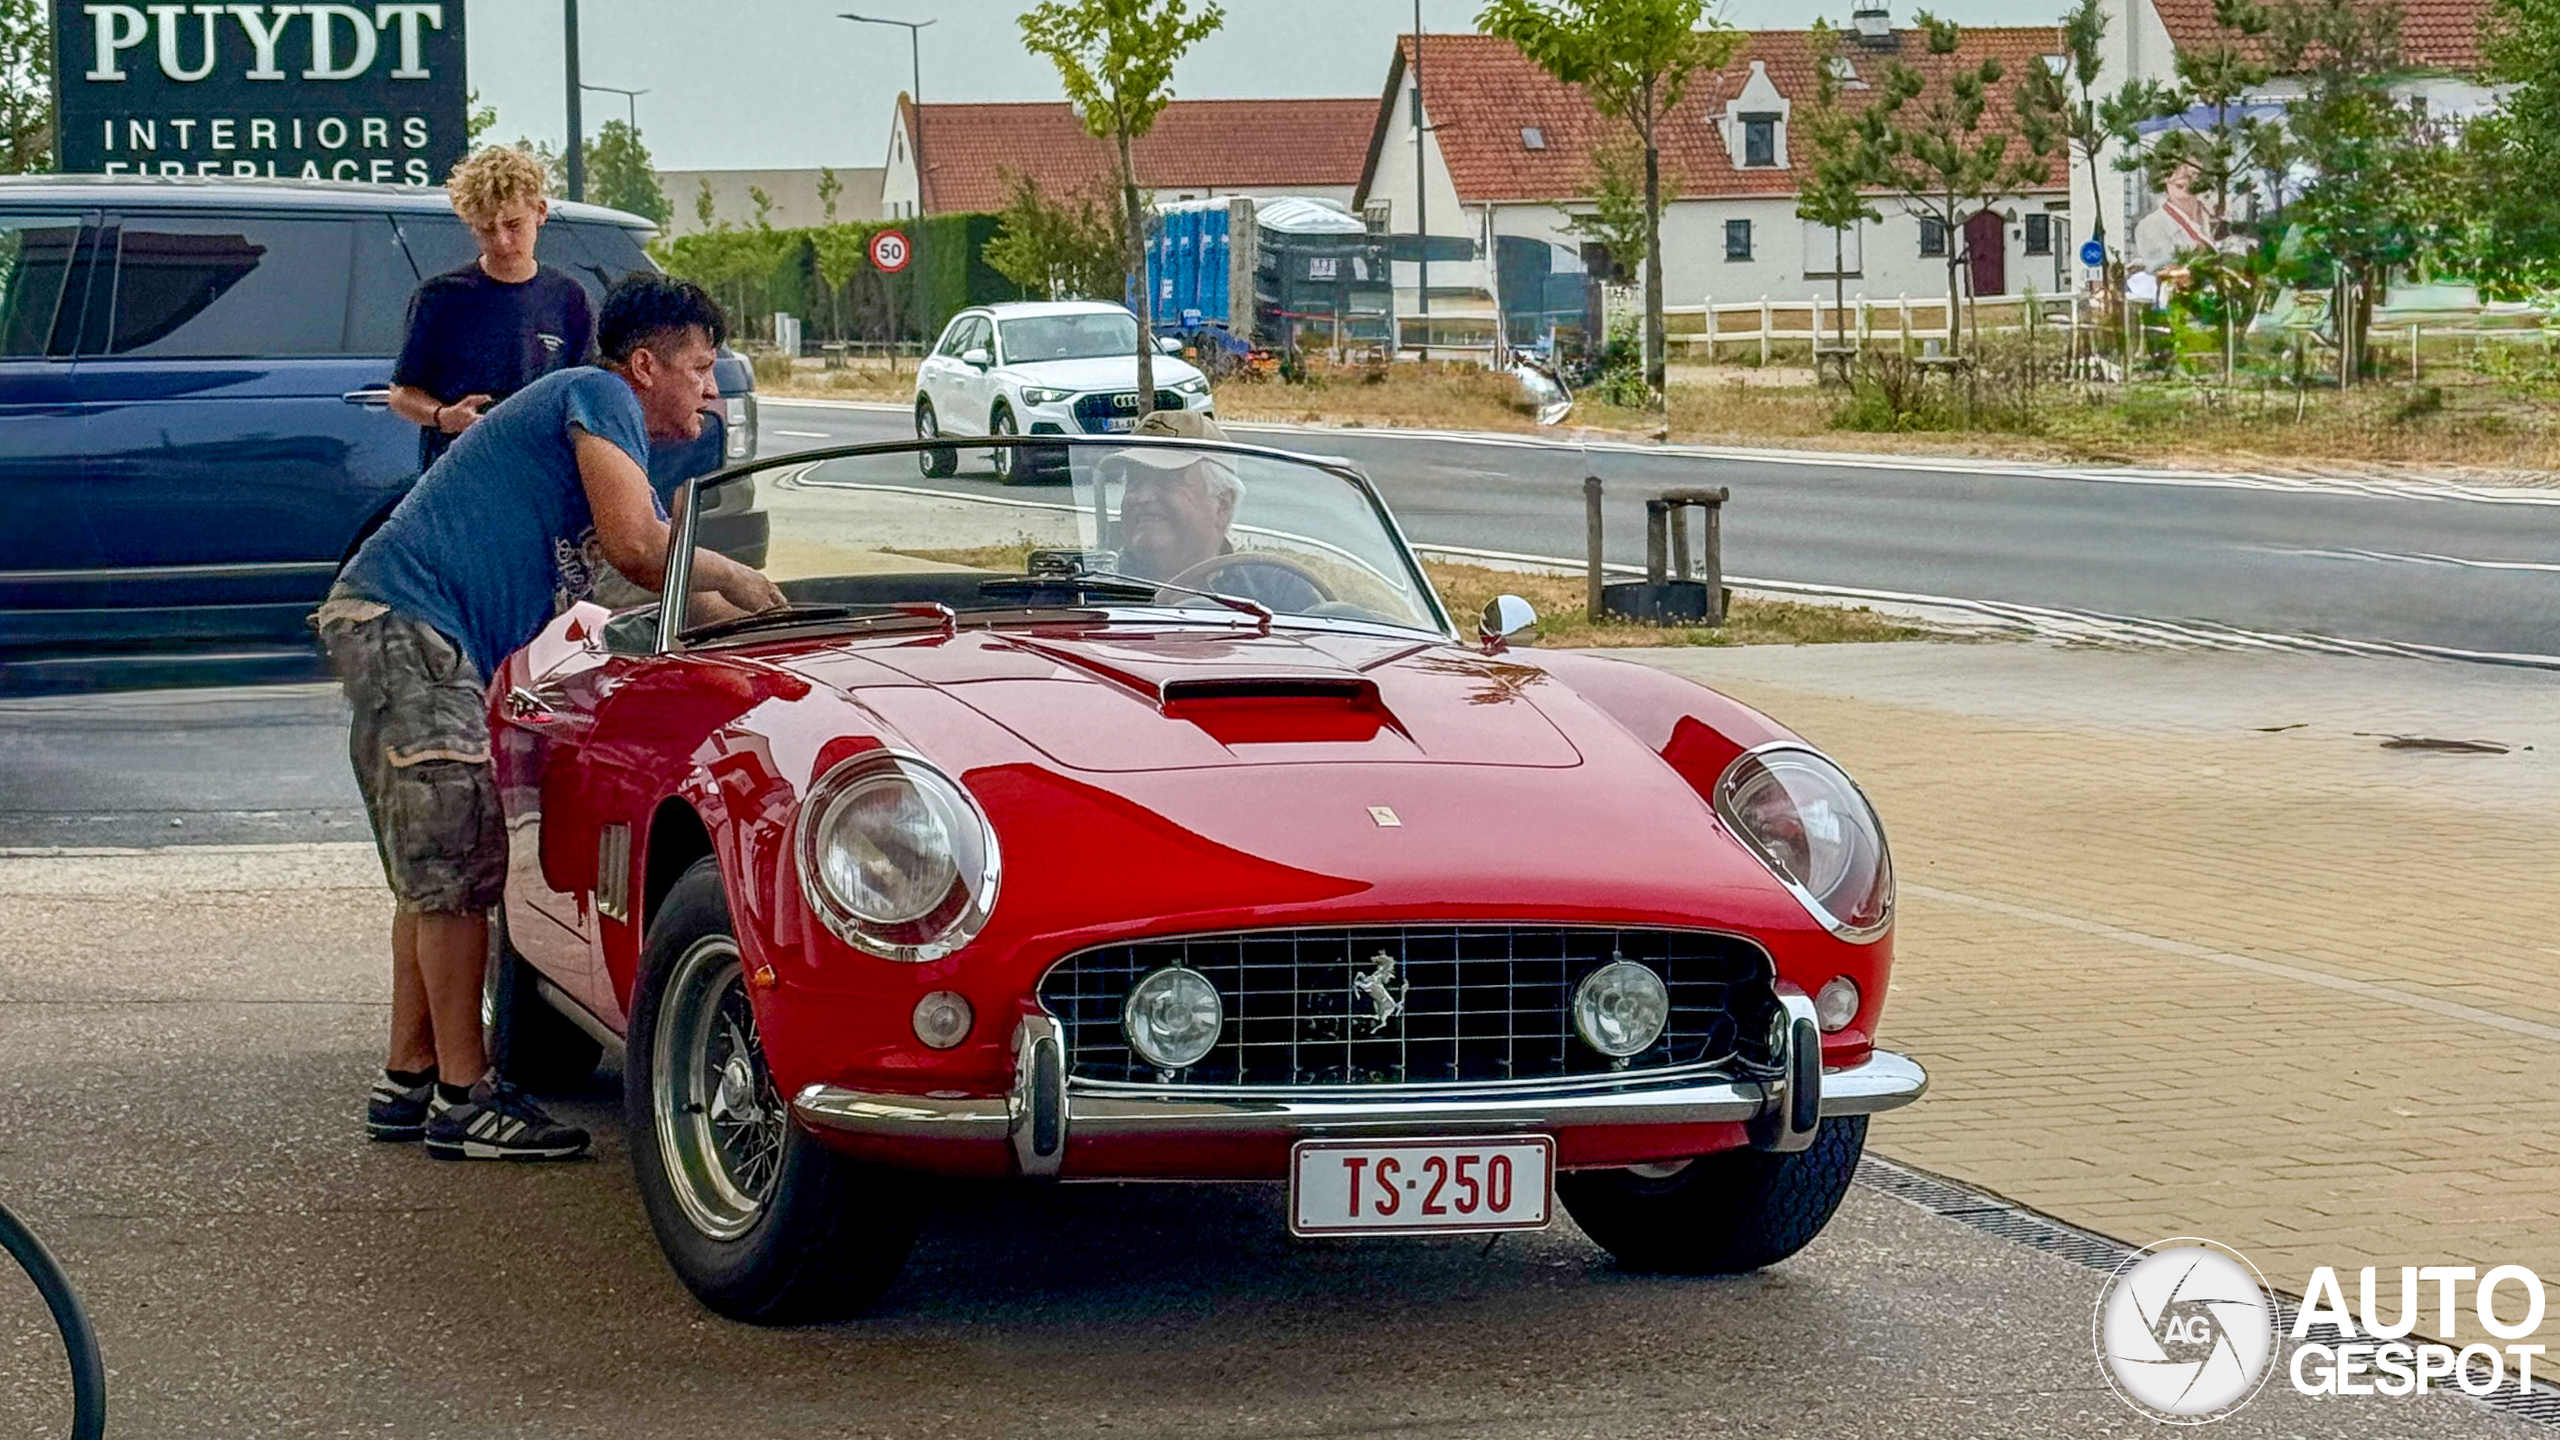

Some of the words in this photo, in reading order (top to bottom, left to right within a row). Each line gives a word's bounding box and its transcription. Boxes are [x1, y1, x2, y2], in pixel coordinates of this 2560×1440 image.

[83, 4, 442, 82] PUYDT
[103, 117, 429, 150] INTERIORS
[880, 243, 902, 260] 50
[1342, 1154, 1512, 1218] TS-250
